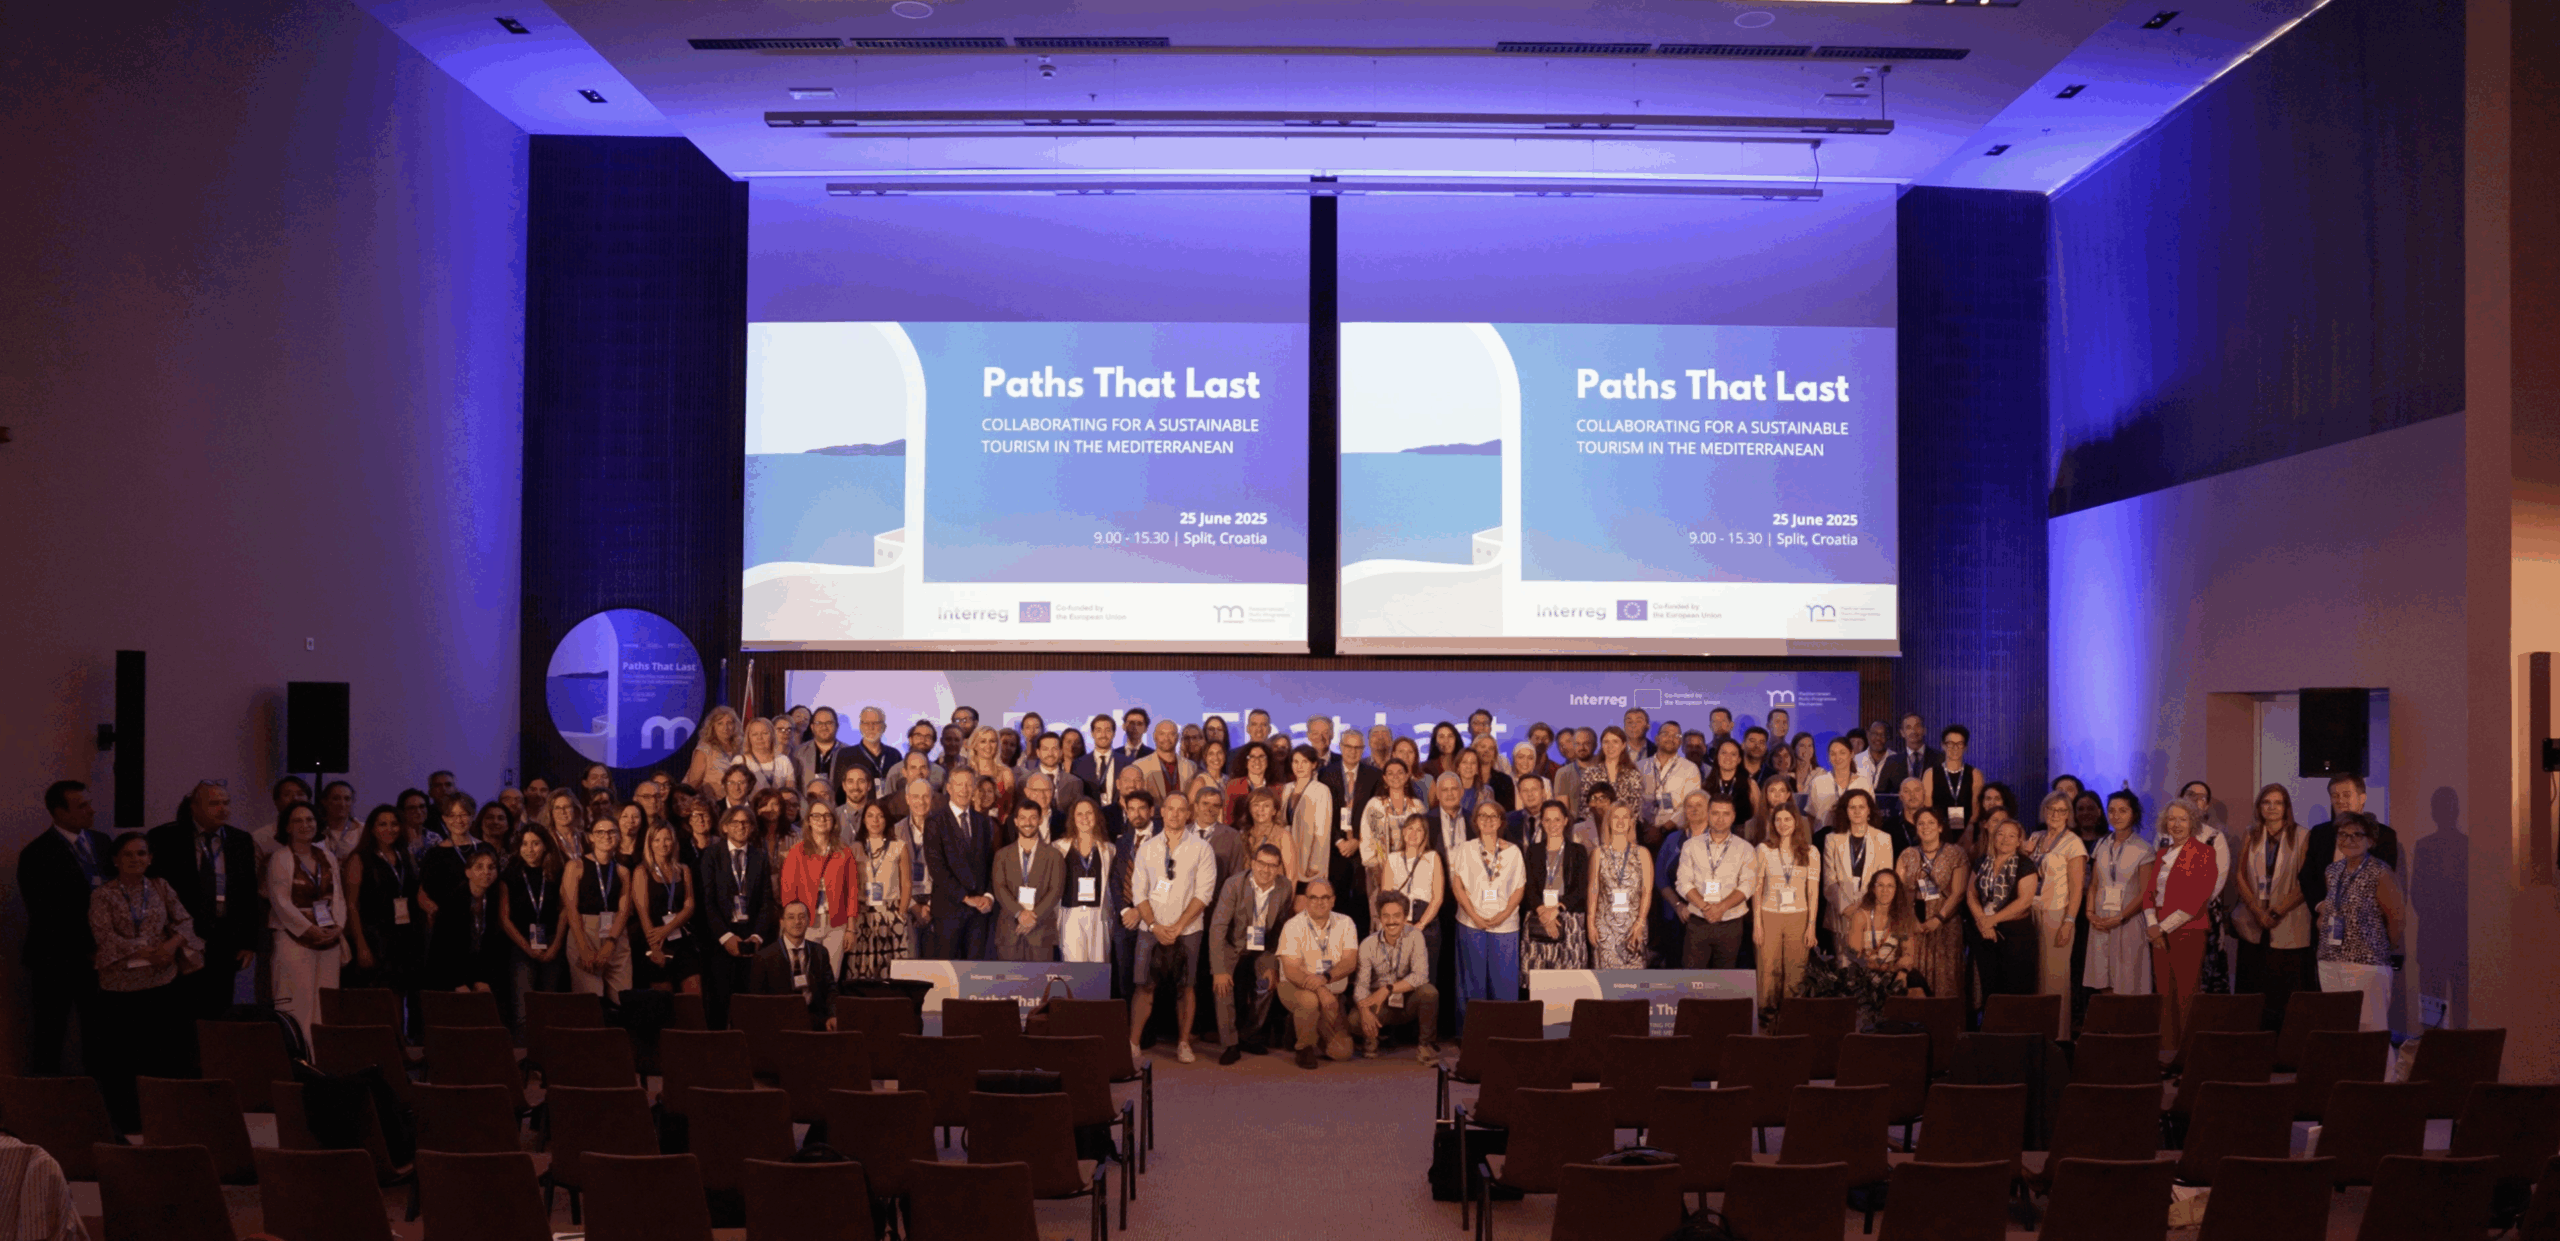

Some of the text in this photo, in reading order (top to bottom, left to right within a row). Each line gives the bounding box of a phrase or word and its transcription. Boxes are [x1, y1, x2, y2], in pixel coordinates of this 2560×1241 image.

[982, 366, 1261, 399] Paths That Last
[1576, 368, 1850, 402] Paths That Last
[981, 418, 1259, 433] COLLABORATING FOR A SUSTAINABLE
[1576, 419, 1849, 435] COLLABORATING FOR A SUSTAINABLE
[981, 440, 1234, 454] TOURISM IN THE MEDITERRANEAN
[1576, 440, 1824, 456] TOURISM IN THE MEDITERRANEAN
[1180, 512, 1268, 527] 25 June 2025
[1772, 513, 1858, 528] 25 June 2025
[1093, 531, 1122, 544] 9.00
[1134, 531, 1170, 544] 15.30
[1183, 532, 1216, 547] Split,
[1219, 532, 1268, 545] Croatia
[1689, 532, 1717, 544] 9.00
[1728, 532, 1763, 545] 15.30
[1777, 532, 1808, 548] Split,
[1812, 532, 1858, 546] Croatia
[1536, 604, 1607, 620] Interreg
[1652, 602, 1690, 610] Co-funded
[938, 606, 1009, 622] Interreg
[1069, 613, 1104, 622] European
[1652, 611, 1664, 619] the
[1666, 612, 1700, 620] European
[622, 662, 696, 672] Paths That Last
[1570, 694, 1628, 708] Interreg
